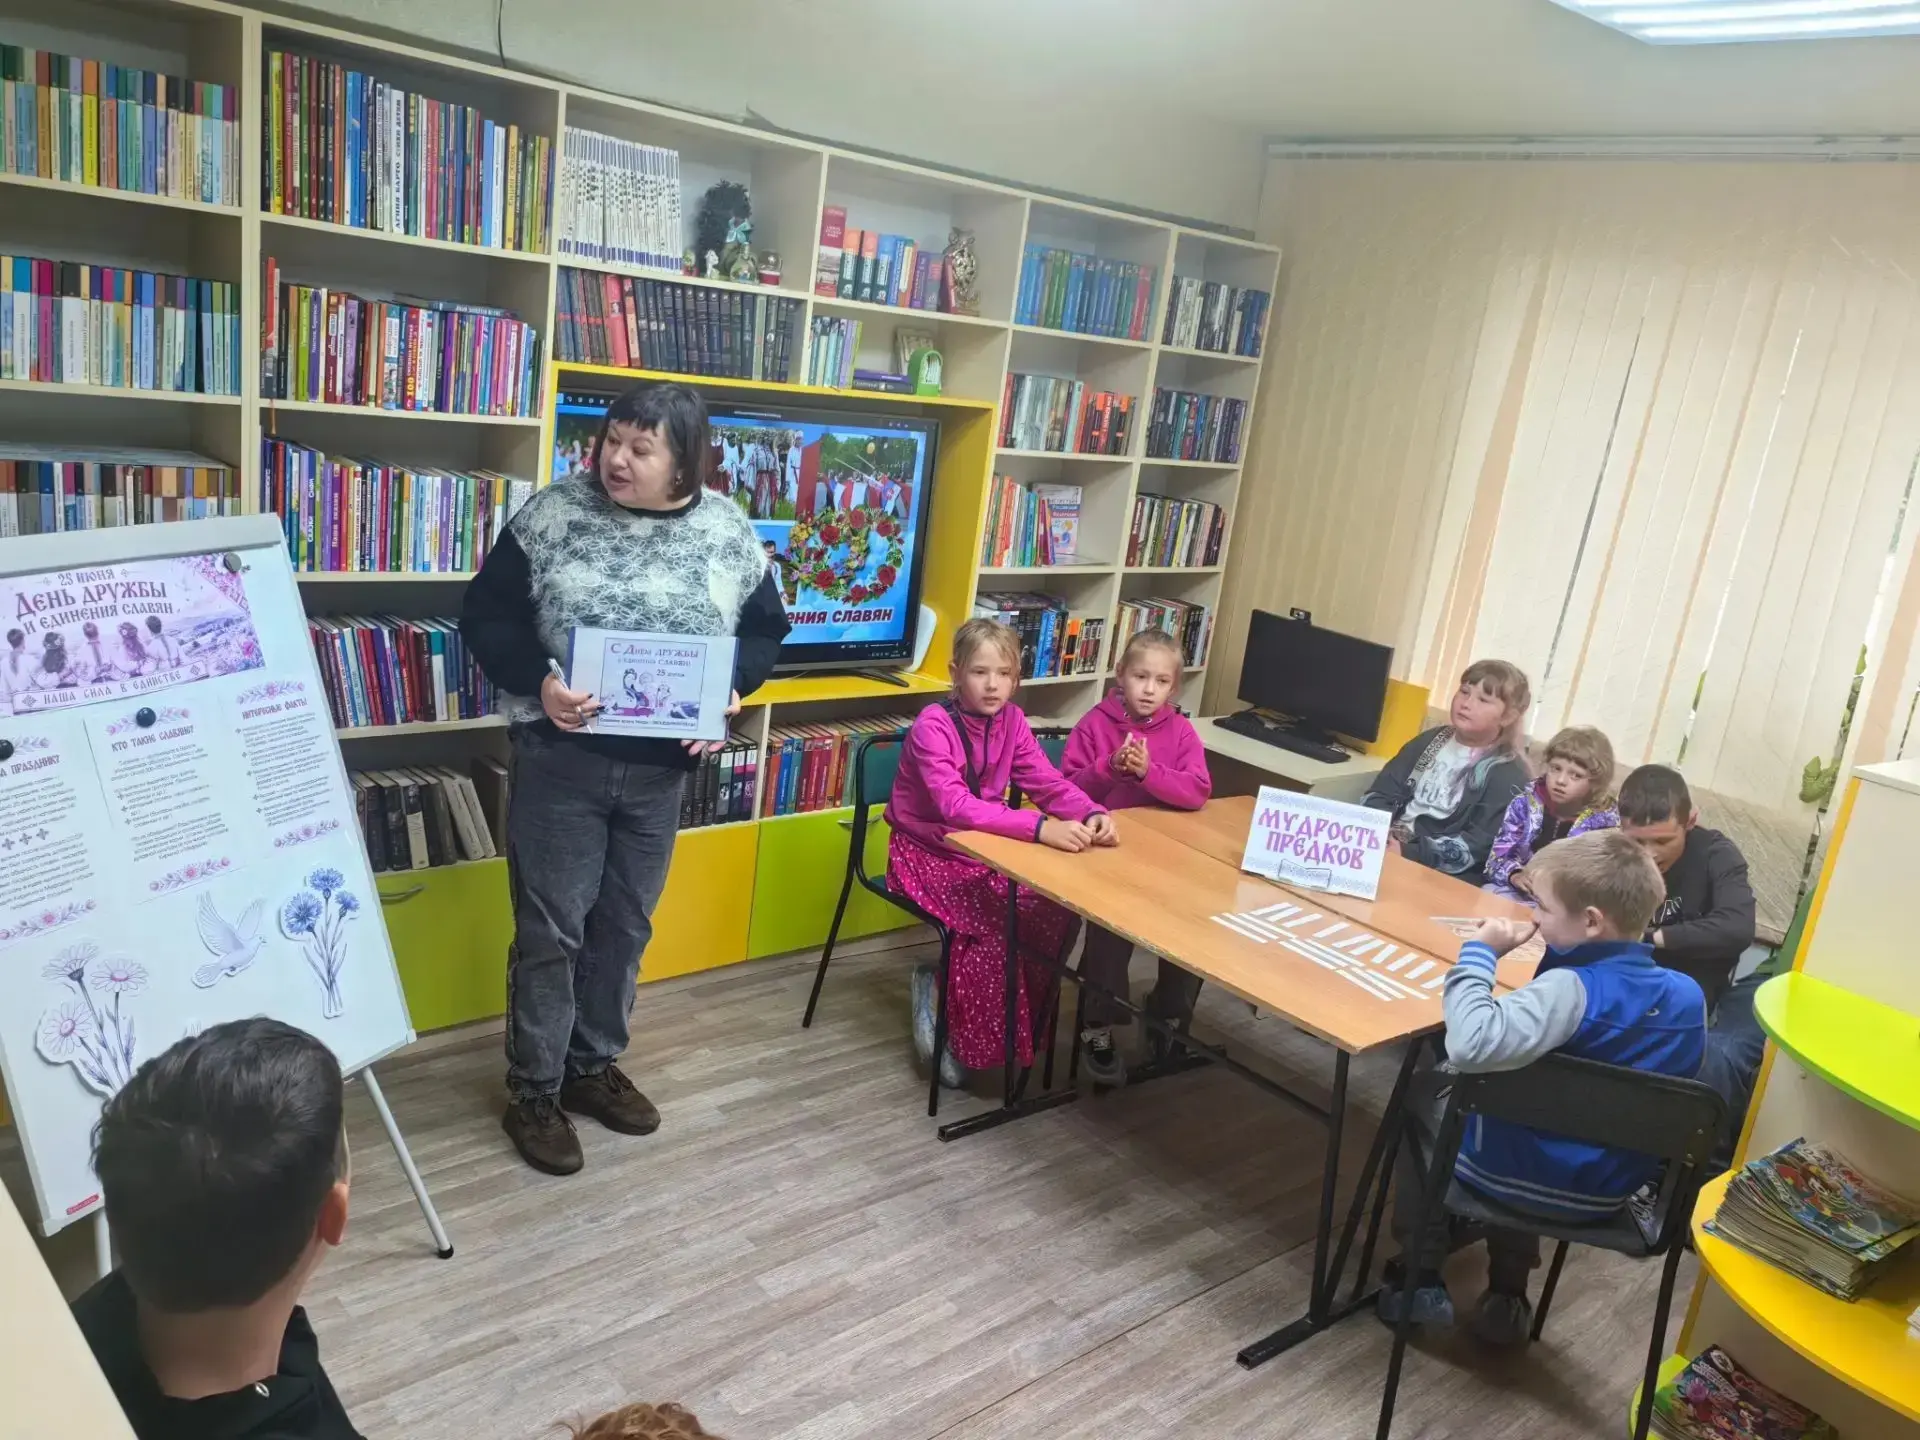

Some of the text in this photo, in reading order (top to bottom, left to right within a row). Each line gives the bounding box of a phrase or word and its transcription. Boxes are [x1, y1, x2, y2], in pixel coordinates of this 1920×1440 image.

[406, 376, 415, 397] 100
[58, 572, 74, 586] 25
[82, 581, 168, 605] ДРУЖБЫ
[23, 602, 174, 635] И ЕДИНЕНИЯ СЛАВЯН
[787, 608, 893, 625] ения славян
[610, 643, 621, 654] С
[656, 668, 666, 676] 25
[44, 691, 77, 705] НАША
[83, 686, 112, 699] СИЛА
[111, 741, 128, 752] КТО
[130, 733, 157, 748] ТАКИЕ
[1258, 807, 1381, 850] МУДРОСТЬ
[1266, 831, 1365, 870] ПРЕДКОВ
